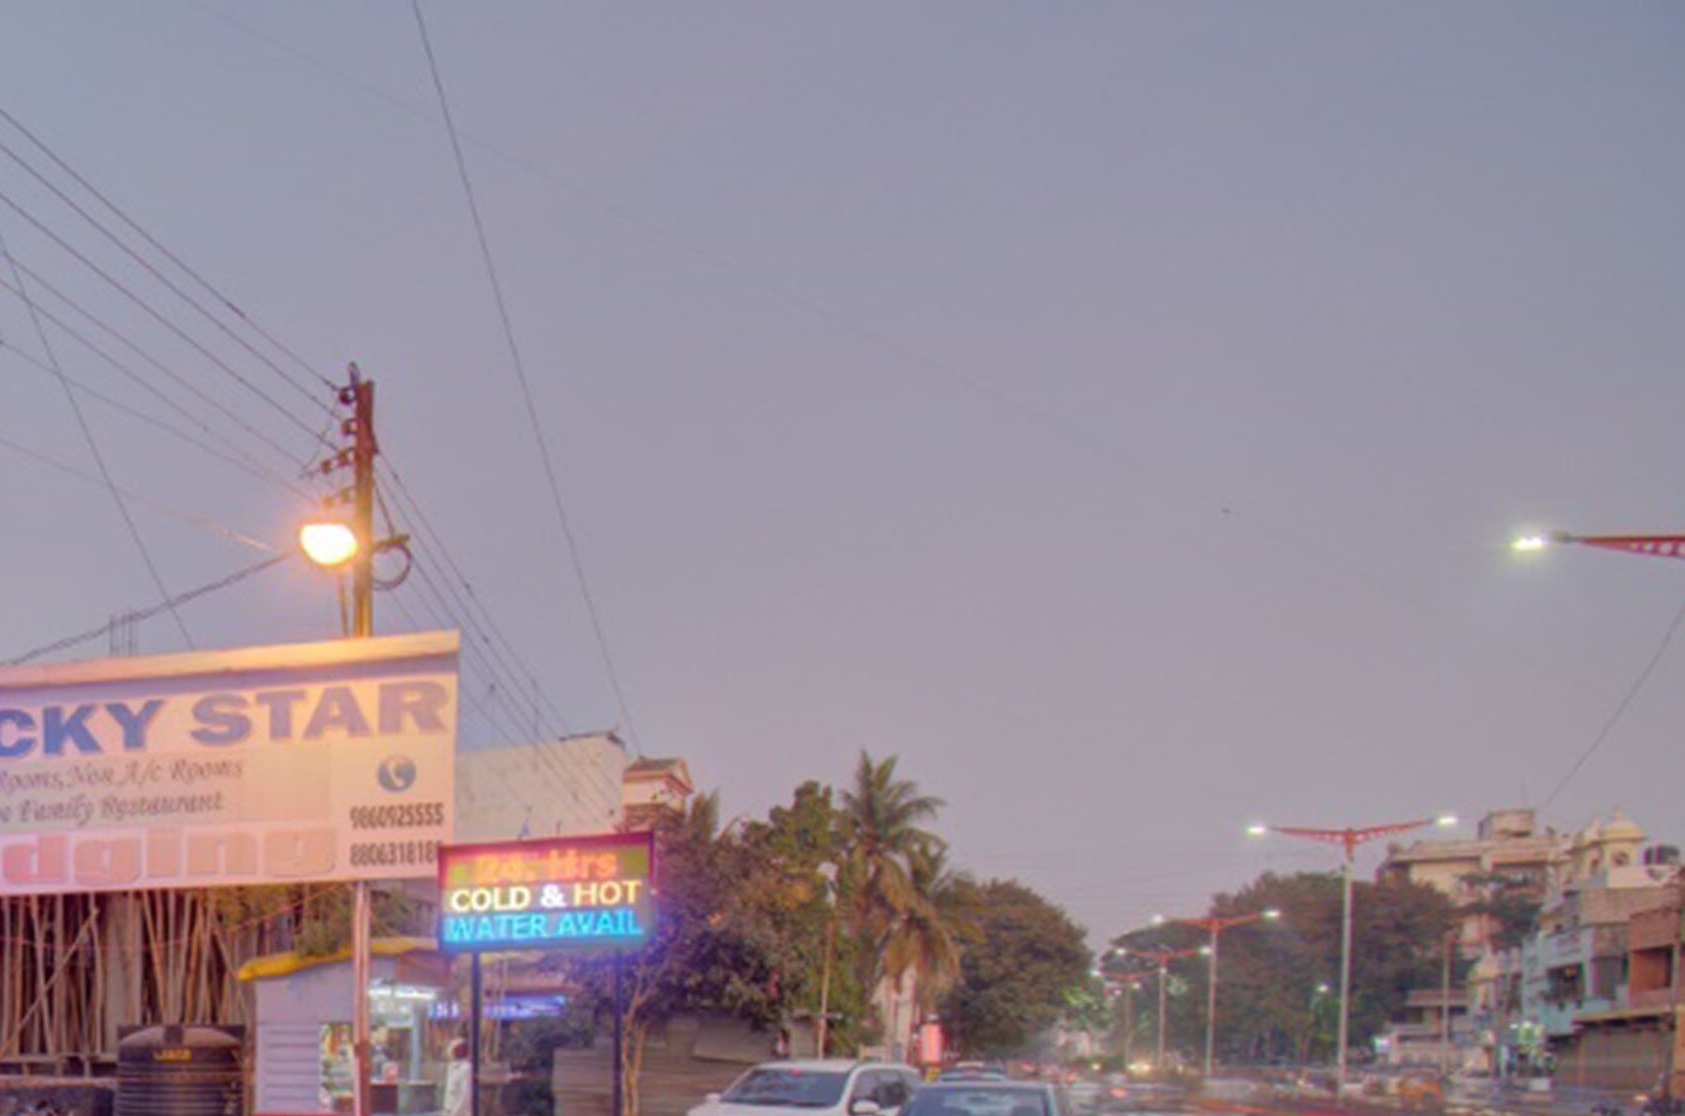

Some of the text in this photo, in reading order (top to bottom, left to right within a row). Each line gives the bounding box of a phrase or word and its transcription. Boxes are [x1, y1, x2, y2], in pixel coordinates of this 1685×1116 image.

[189, 681, 449, 746] STAR
[171, 758, 244, 785] Rooms
[18, 794, 94, 826] Family
[101, 791, 225, 821] Restaurant
[349, 839, 442, 867] 880631818
[450, 880, 642, 913] COLD & HOT
[443, 909, 645, 943] WATER AVAIL
